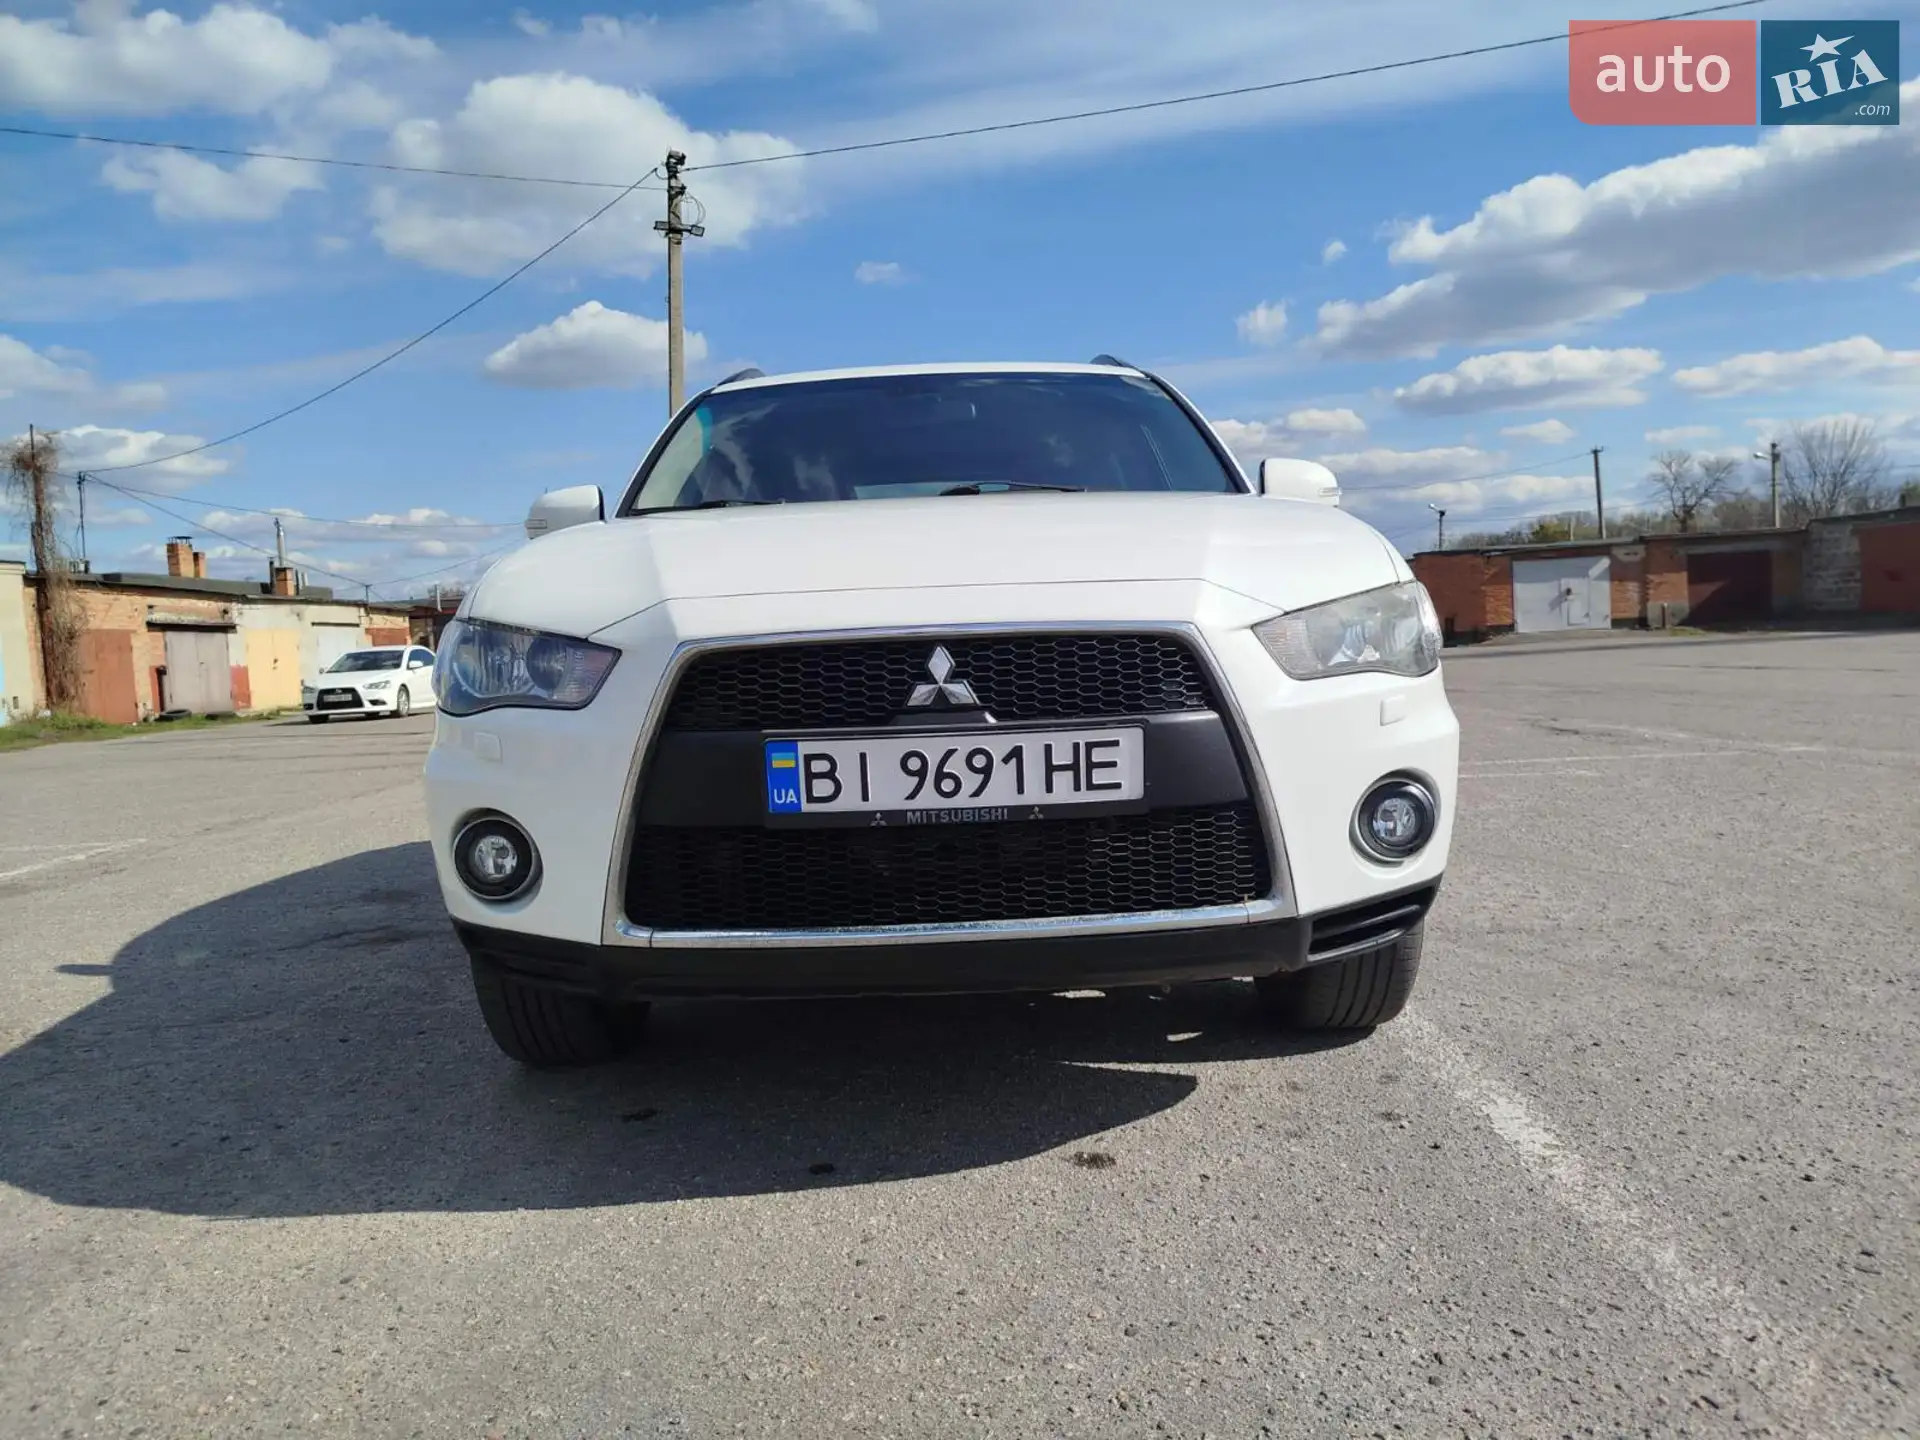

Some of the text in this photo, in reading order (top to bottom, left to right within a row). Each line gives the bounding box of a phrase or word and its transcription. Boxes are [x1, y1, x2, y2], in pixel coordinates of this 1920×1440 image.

[804, 739, 1122, 803] BI 9691 HE
[774, 788, 798, 804] UA
[906, 807, 1009, 825] MITSUBISHI
